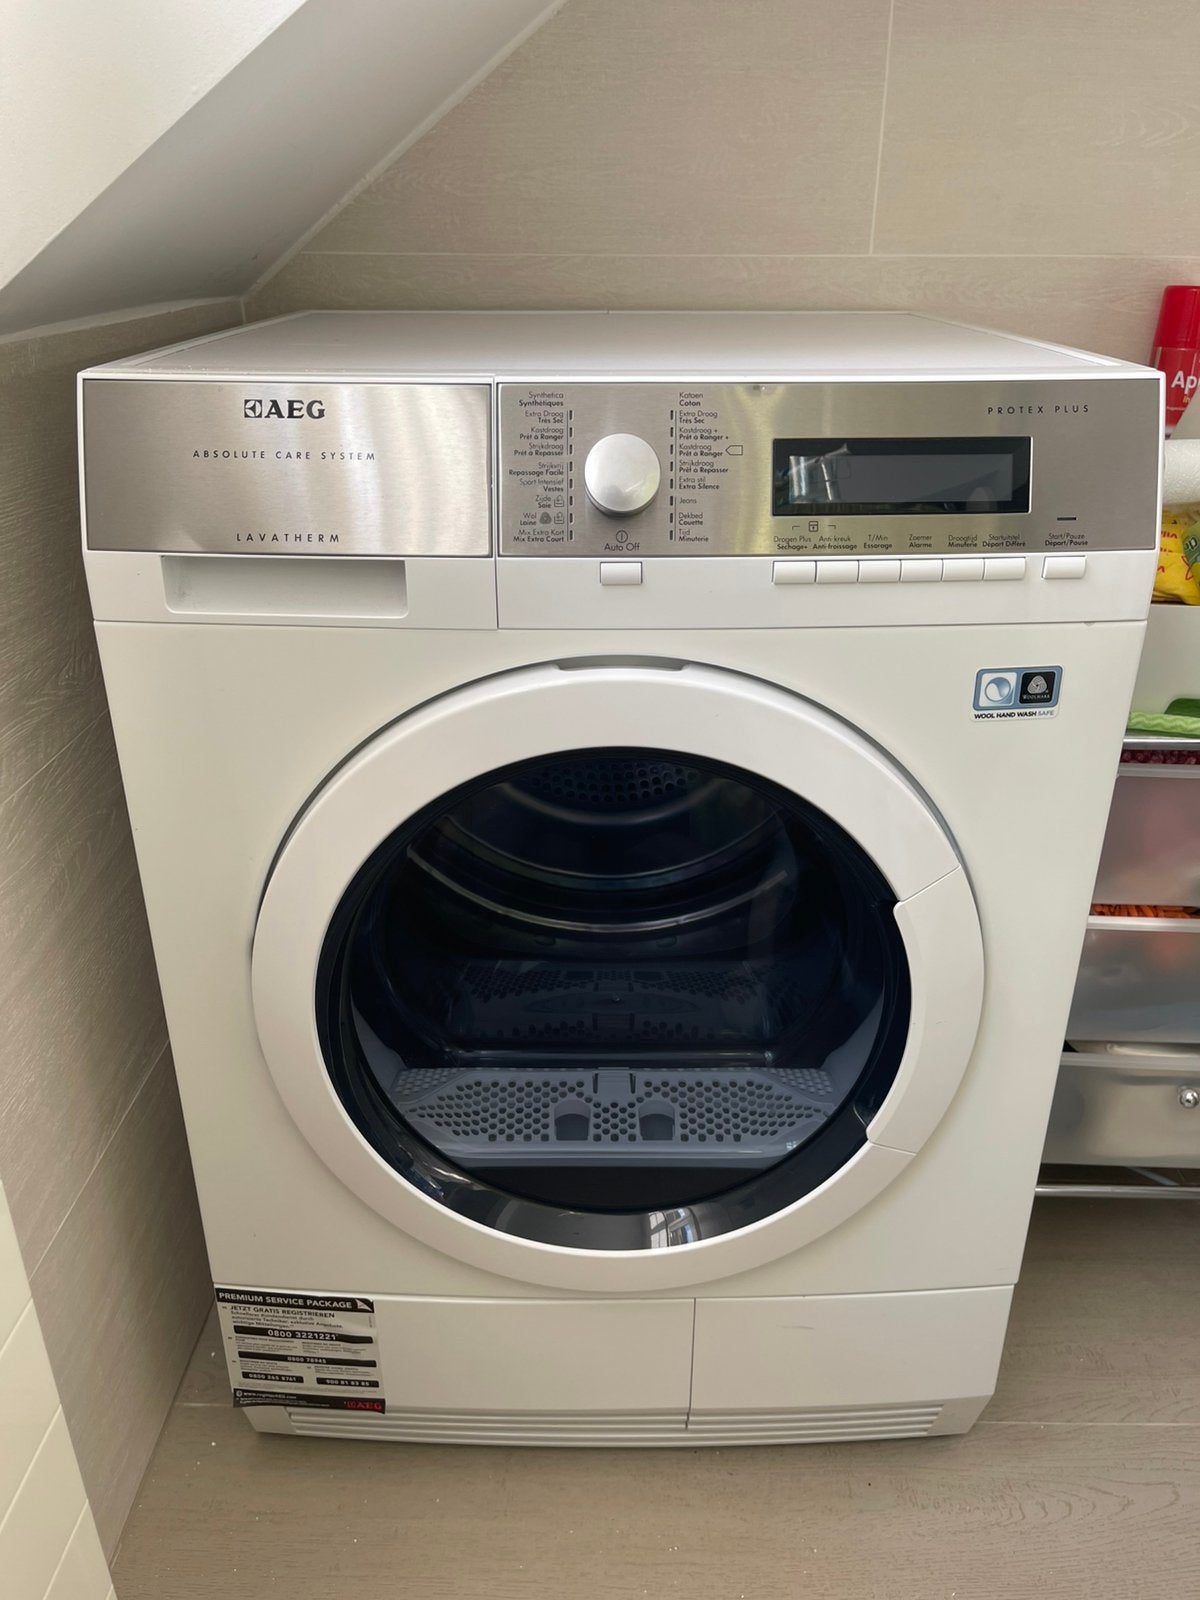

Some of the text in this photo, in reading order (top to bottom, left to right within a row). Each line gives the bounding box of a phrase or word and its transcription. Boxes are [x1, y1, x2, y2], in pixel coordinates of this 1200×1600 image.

[1171, 370, 1200, 395] Ap
[528, 391, 564, 400] Synthetica
[679, 399, 701, 407] Coton
[264, 399, 326, 419] AEG
[987, 404, 1090, 415] PROTEX PLUS
[543, 410, 564, 418] Droog
[697, 410, 718, 419] Droog
[679, 427, 712, 435] Kastdroog
[540, 433, 564, 441] Ranger
[700, 433, 723, 441] Ranger
[528, 442, 564, 450] Strijkdroog
[679, 443, 712, 451] Kastdroog
[193, 450, 376, 461] ABSOLUTE CARE SYSTEM
[534, 449, 564, 457] Repasser
[700, 450, 723, 458] Ranger
[679, 459, 715, 468] Strijkdroog
[508, 469, 544, 477] Repassage
[700, 466, 729, 474] Repasser
[519, 478, 536, 486] Sport
[535, 494, 552, 503] Zijde
[679, 529, 691, 537] Tijd
[1048, 532, 1086, 540] Start/Pauze
[236, 533, 340, 543] LAVATHERM
[773, 536, 798, 544] Drogen
[948, 534, 978, 543] Droogtijd
[604, 543, 641, 552] Auto Off
[218, 1292, 353, 1309] PREMIUM SERVICE PACKAGE
[253, 1307, 280, 1315] GRATIS
[281, 1309, 336, 1319] REGISTRIEREN
[267, 1329, 292, 1338] 0800
